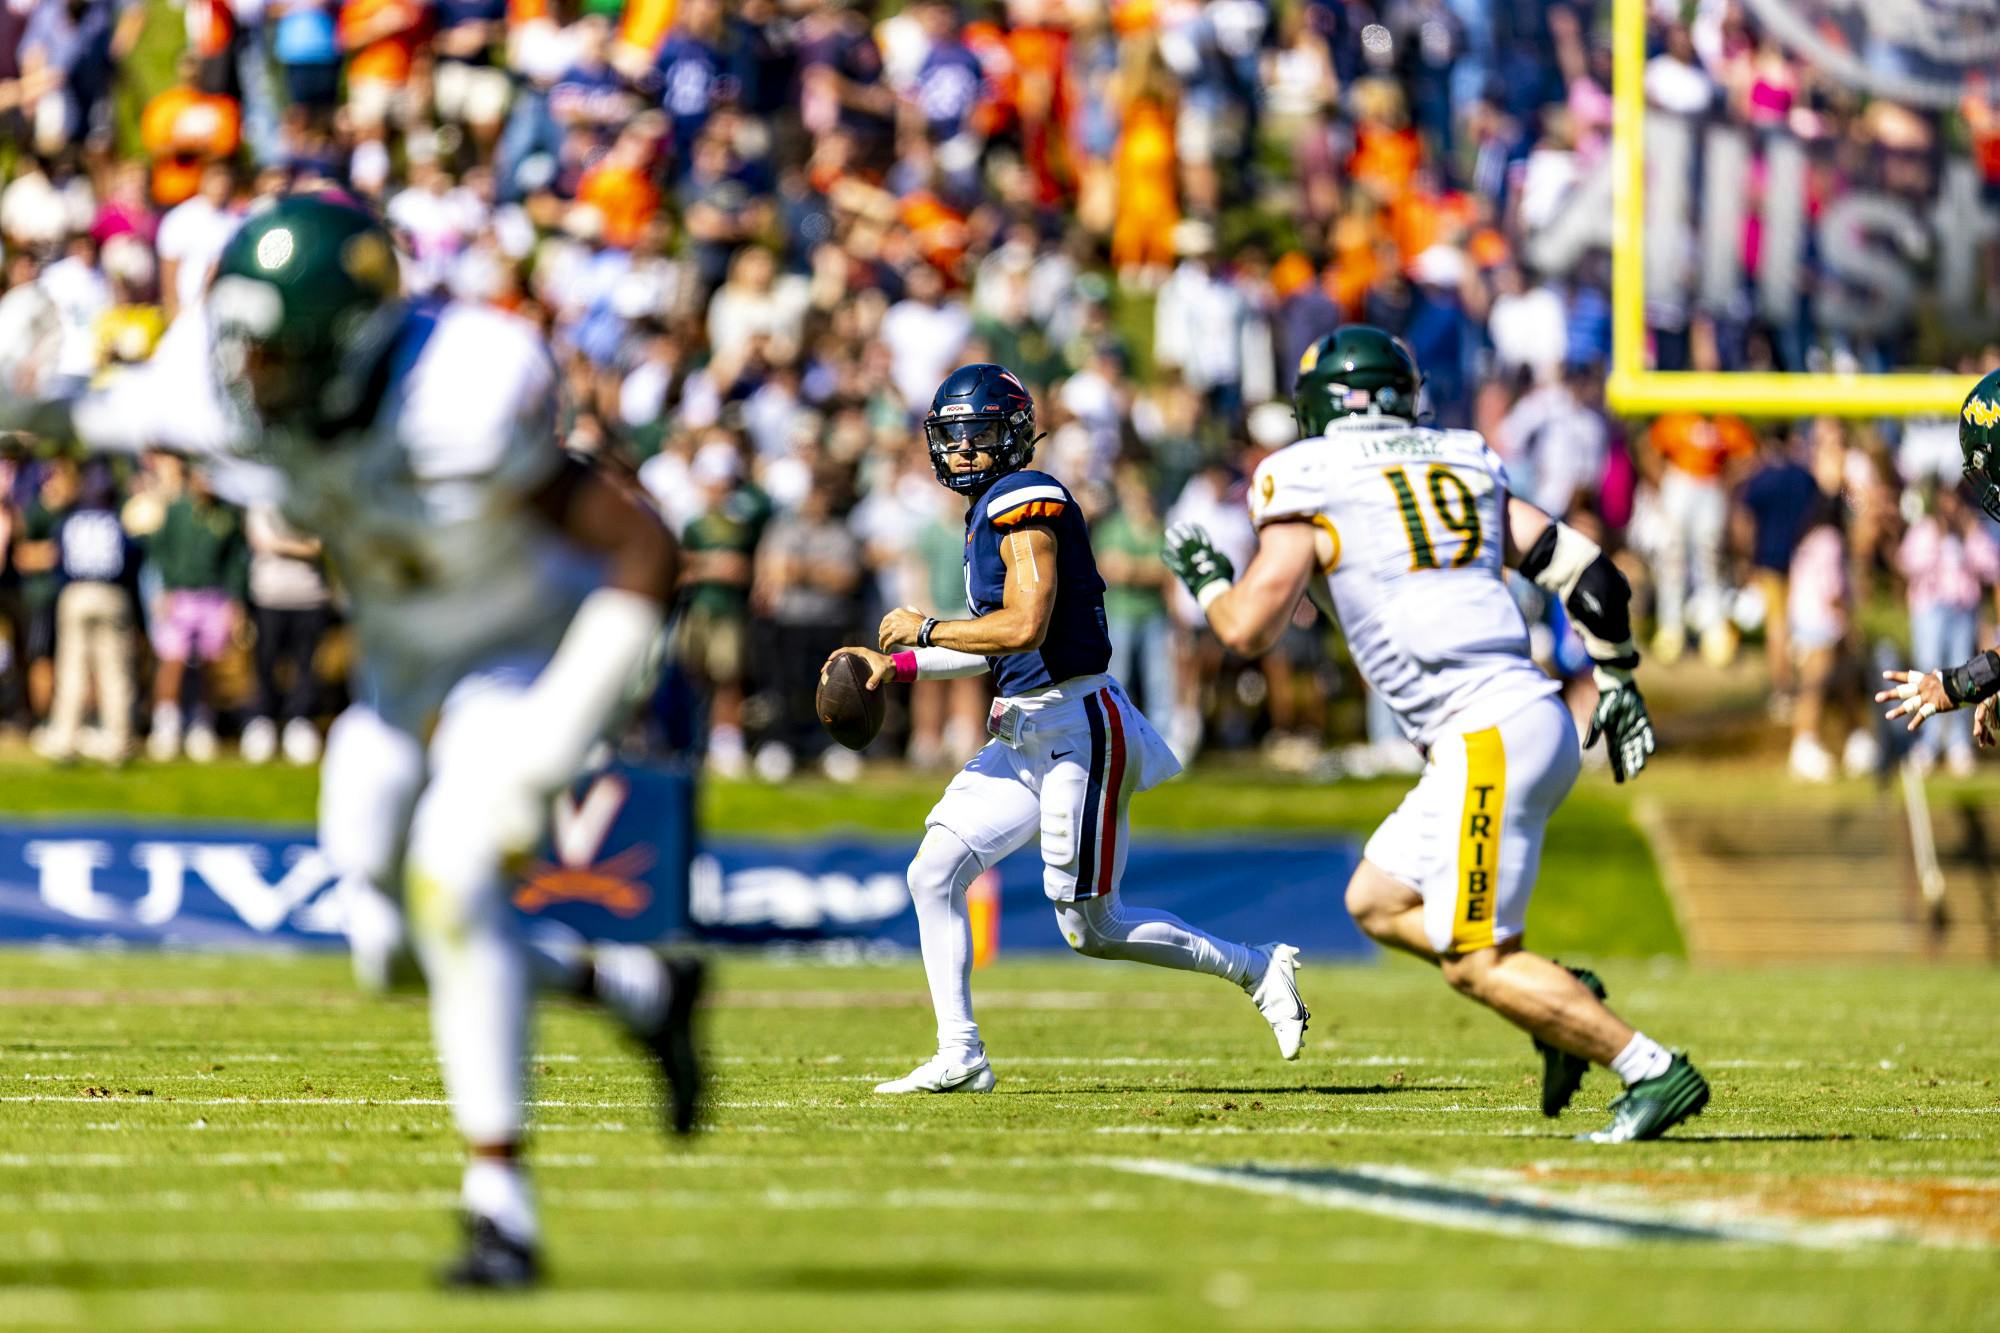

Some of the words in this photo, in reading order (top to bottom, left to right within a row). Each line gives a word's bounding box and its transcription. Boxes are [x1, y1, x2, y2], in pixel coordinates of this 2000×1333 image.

[1382, 462, 1483, 572] 19
[24, 839, 345, 932] UV
[1466, 785, 1495, 922] TRIBE
